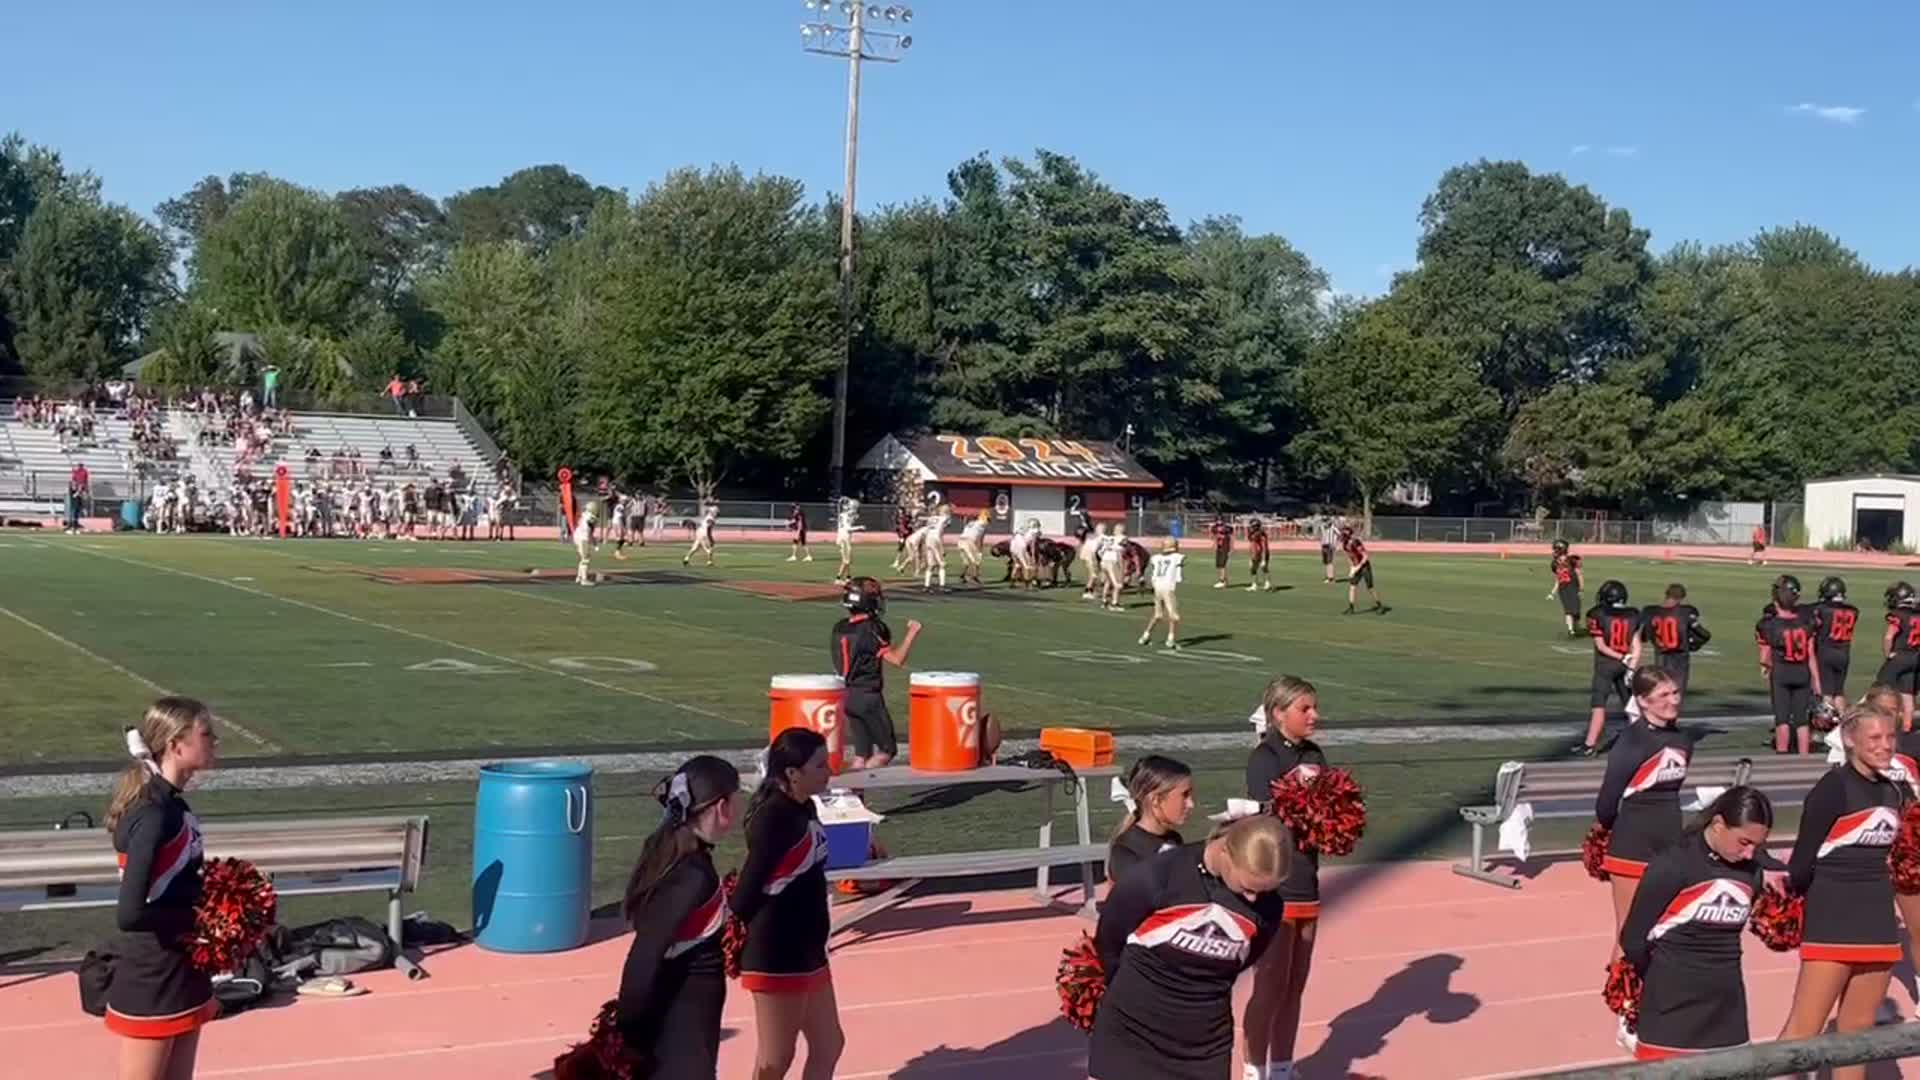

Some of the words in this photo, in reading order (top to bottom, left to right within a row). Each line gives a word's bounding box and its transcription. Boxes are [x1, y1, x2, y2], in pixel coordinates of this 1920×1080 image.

[936, 435, 1102, 469] 2024
[962, 458, 1129, 480] SENIORS
[1069, 495, 1081, 515] 2
[1132, 496, 1144, 517] 4
[1157, 560, 1172, 577] 17
[841, 636, 850, 674] 1
[1783, 628, 1808, 662] 13
[816, 705, 837, 729] G
[959, 701, 977, 726] G
